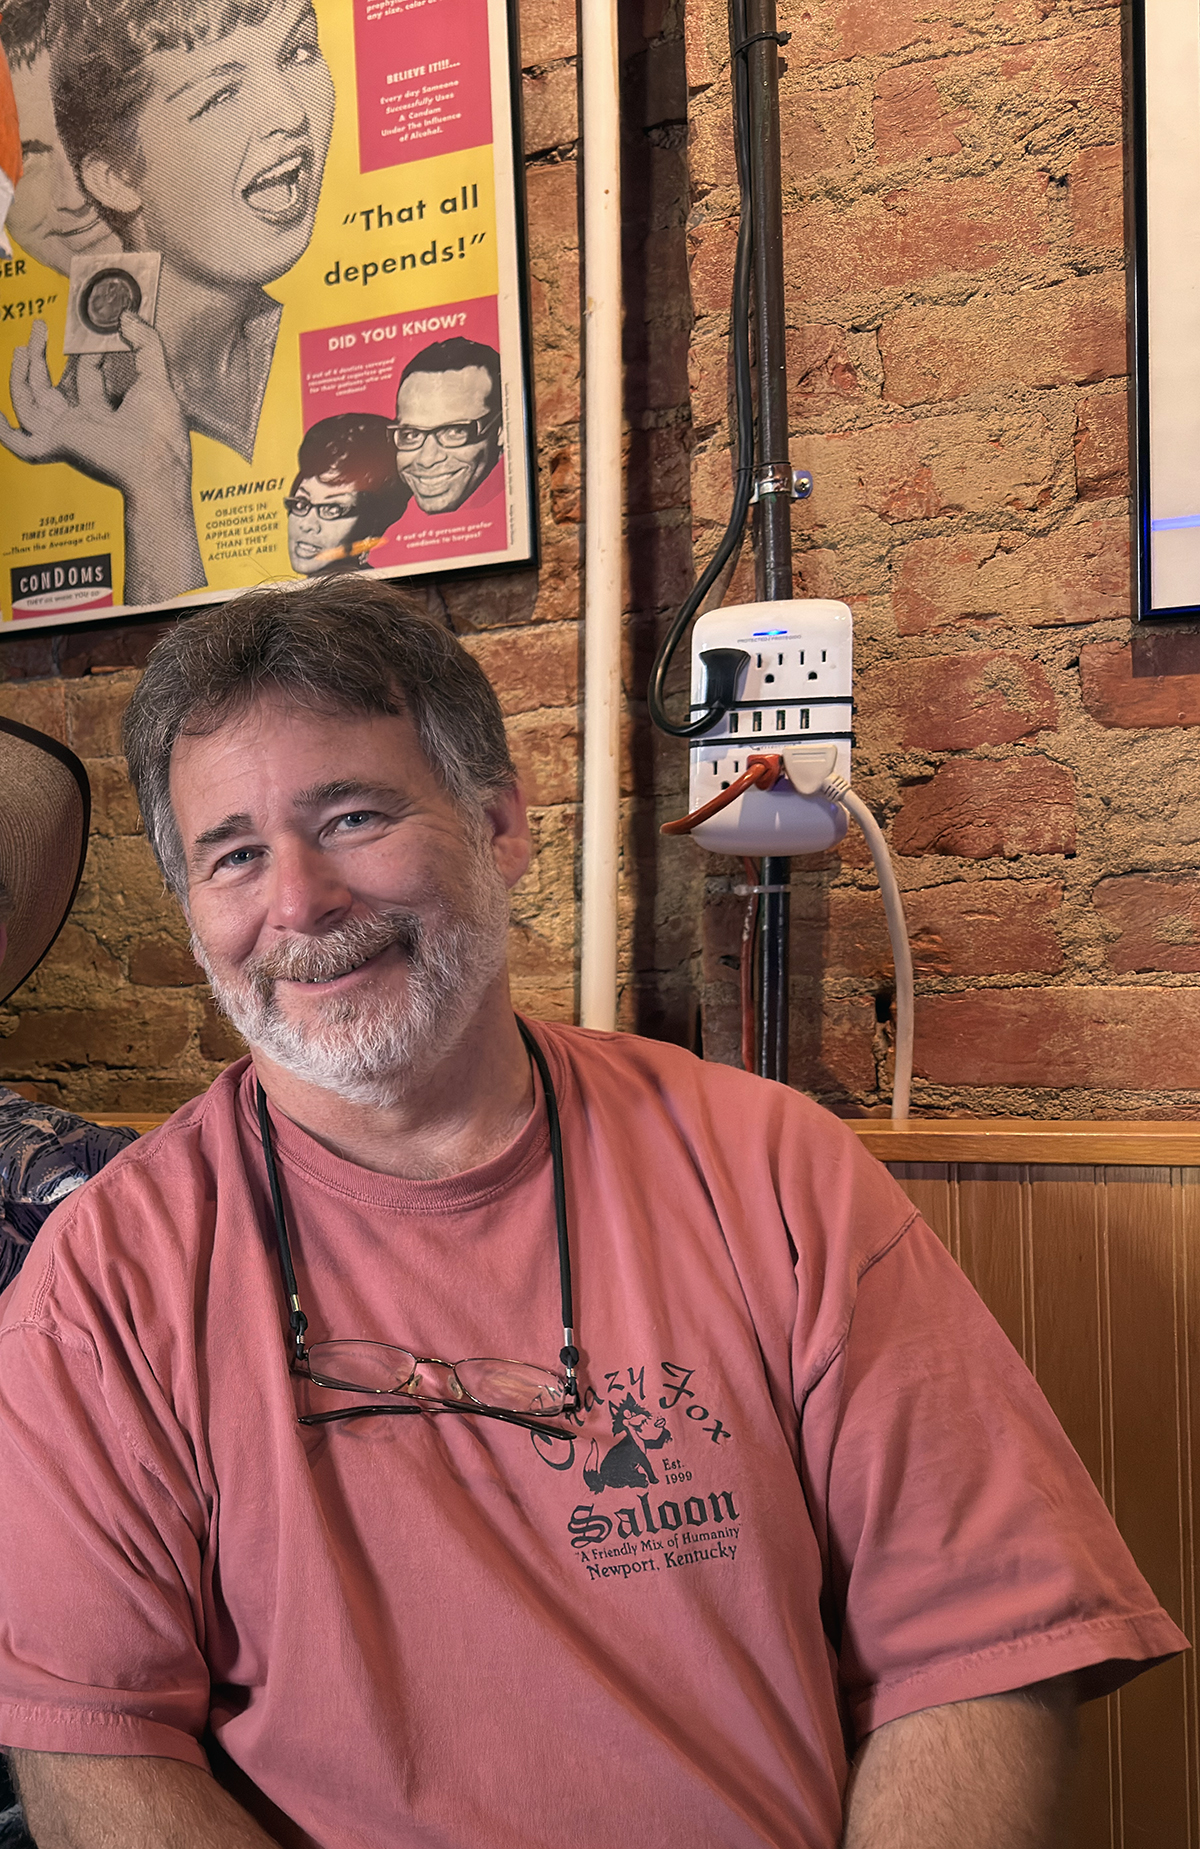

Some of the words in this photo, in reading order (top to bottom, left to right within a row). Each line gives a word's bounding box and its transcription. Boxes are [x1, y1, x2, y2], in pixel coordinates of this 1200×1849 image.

[386, 66, 426, 84] BELIEVE
[380, 94, 403, 105] Every
[404, 90, 420, 98] day
[422, 80, 459, 94] Someone
[386, 97, 434, 114] Successfully
[434, 92, 454, 102] Uses
[380, 126, 406, 137] Under
[408, 122, 422, 130] The
[424, 113, 462, 126] Influence
[398, 114, 406, 122] A
[408, 107, 442, 120] Condom
[398, 134, 409, 142] of
[410, 126, 443, 140] Alcohol.
[342, 200, 426, 231] "That
[440, 183, 478, 214] all
[324, 232, 486, 286] depends!"
[328, 332, 356, 352] DID
[360, 325, 398, 344] YOU
[402, 312, 468, 337] KNOW?
[200, 478, 284, 502] WARNING!
[205, 516, 254, 530] CONDOMS
[257, 511, 278, 522] MAY
[215, 504, 254, 518] OBJECTS
[256, 502, 267, 511] IN
[22, 529, 46, 542] TIMES
[205, 528, 241, 541] APPEAR
[244, 522, 279, 535] LARGER
[216, 539, 242, 550] THAN
[245, 534, 268, 545] THEY
[208, 548, 252, 562] ACTUALLY
[20, 566, 104, 593] CONDOMS
[658, 1362, 732, 1445] Fox
[662, 1458, 685, 1472] Est.
[665, 1471, 692, 1485] 1999
[568, 1491, 740, 1549] Saloon
[592, 1543, 638, 1560] Friendly
[641, 1540, 664, 1551] Mix
[667, 1533, 679, 1549] of
[664, 1541, 737, 1568] Kentucky
